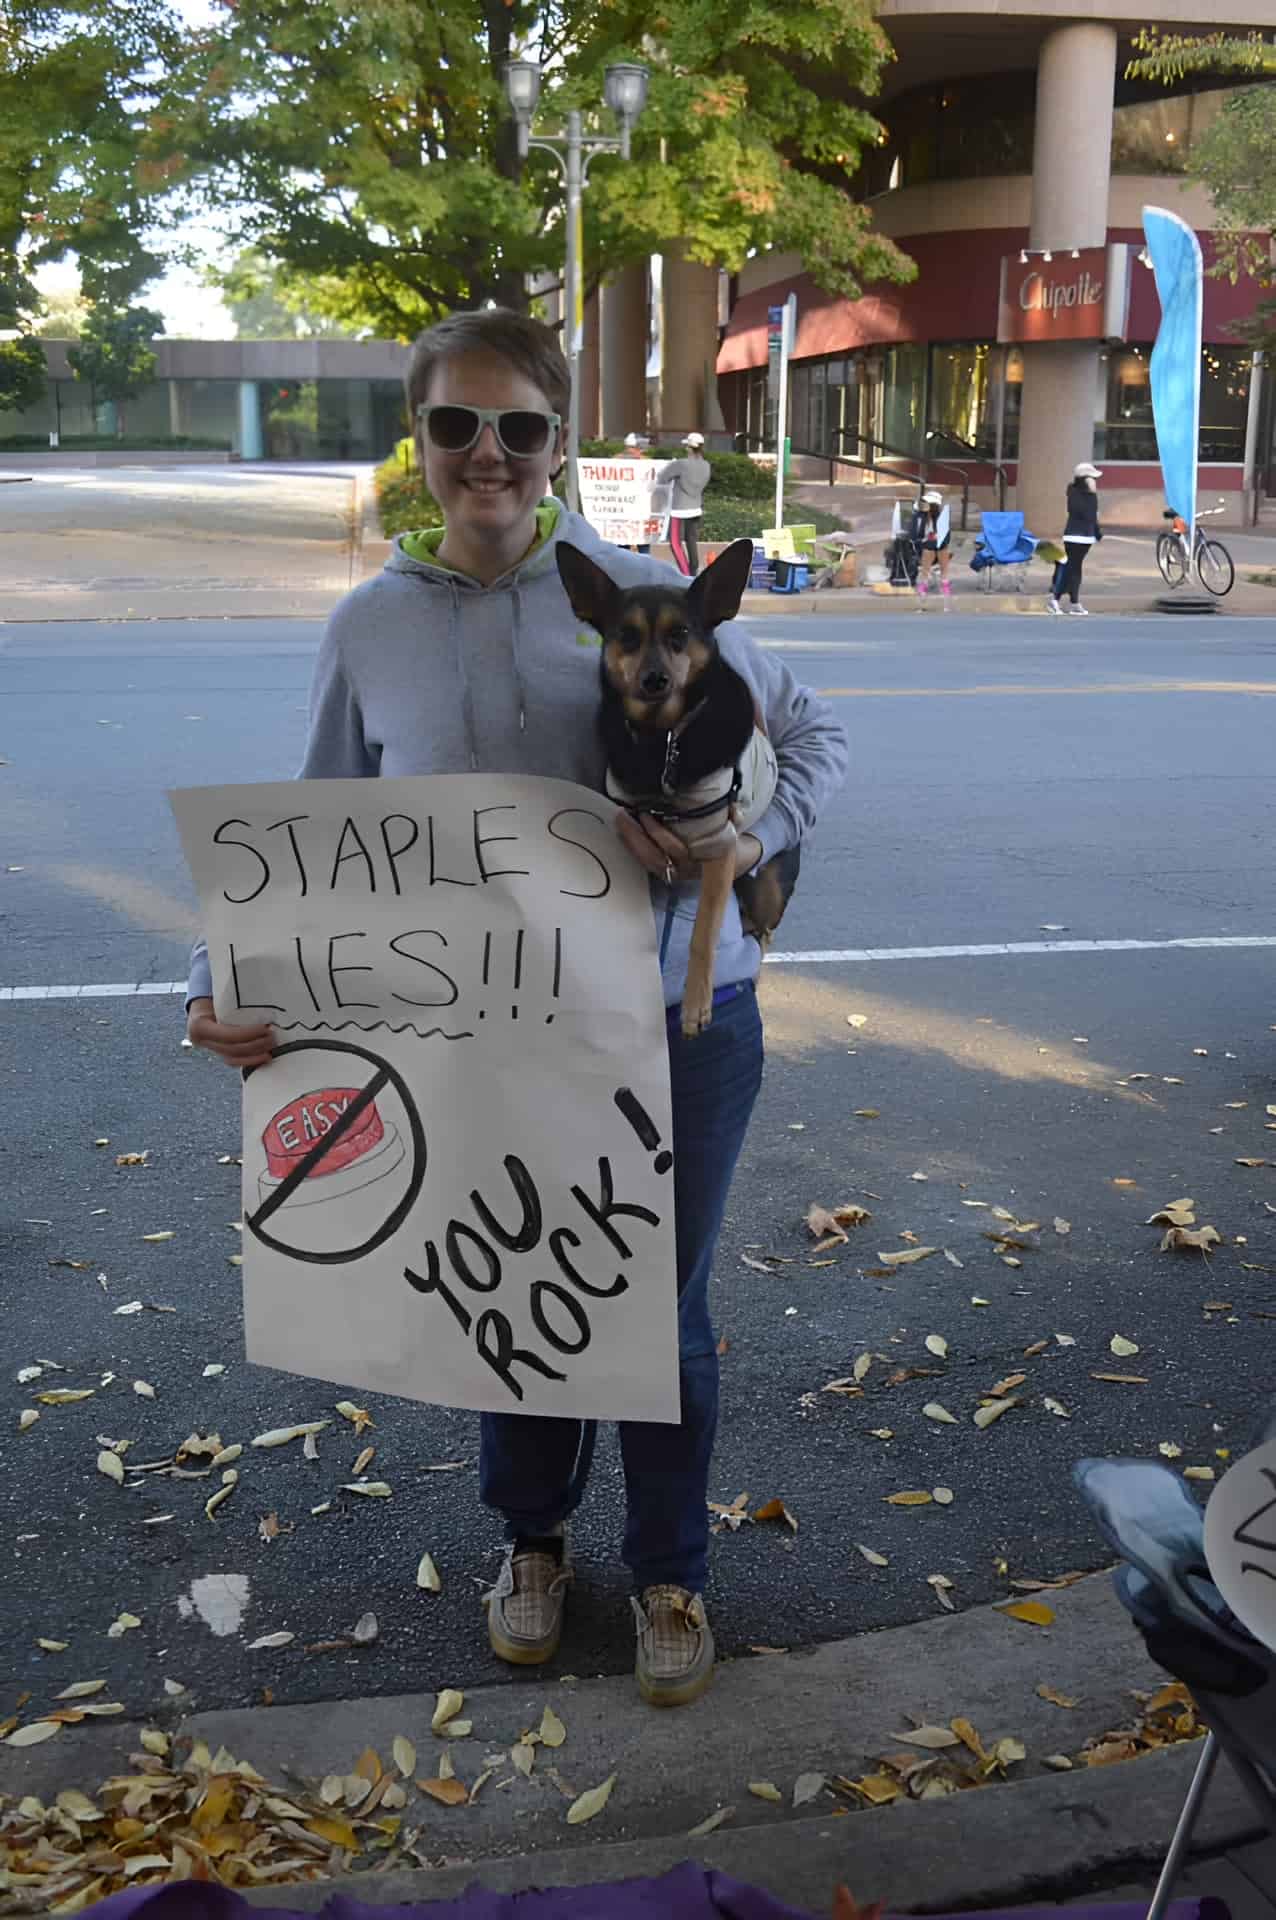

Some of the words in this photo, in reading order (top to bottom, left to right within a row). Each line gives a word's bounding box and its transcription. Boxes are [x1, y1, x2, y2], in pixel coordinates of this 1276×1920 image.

[1019, 271, 1104, 319] Chipotle
[212, 805, 612, 904] STAPLES
[229, 927, 562, 1025] LIES!!!
[276, 1096, 349, 1150] EASY
[403, 1153, 543, 1337] YOU
